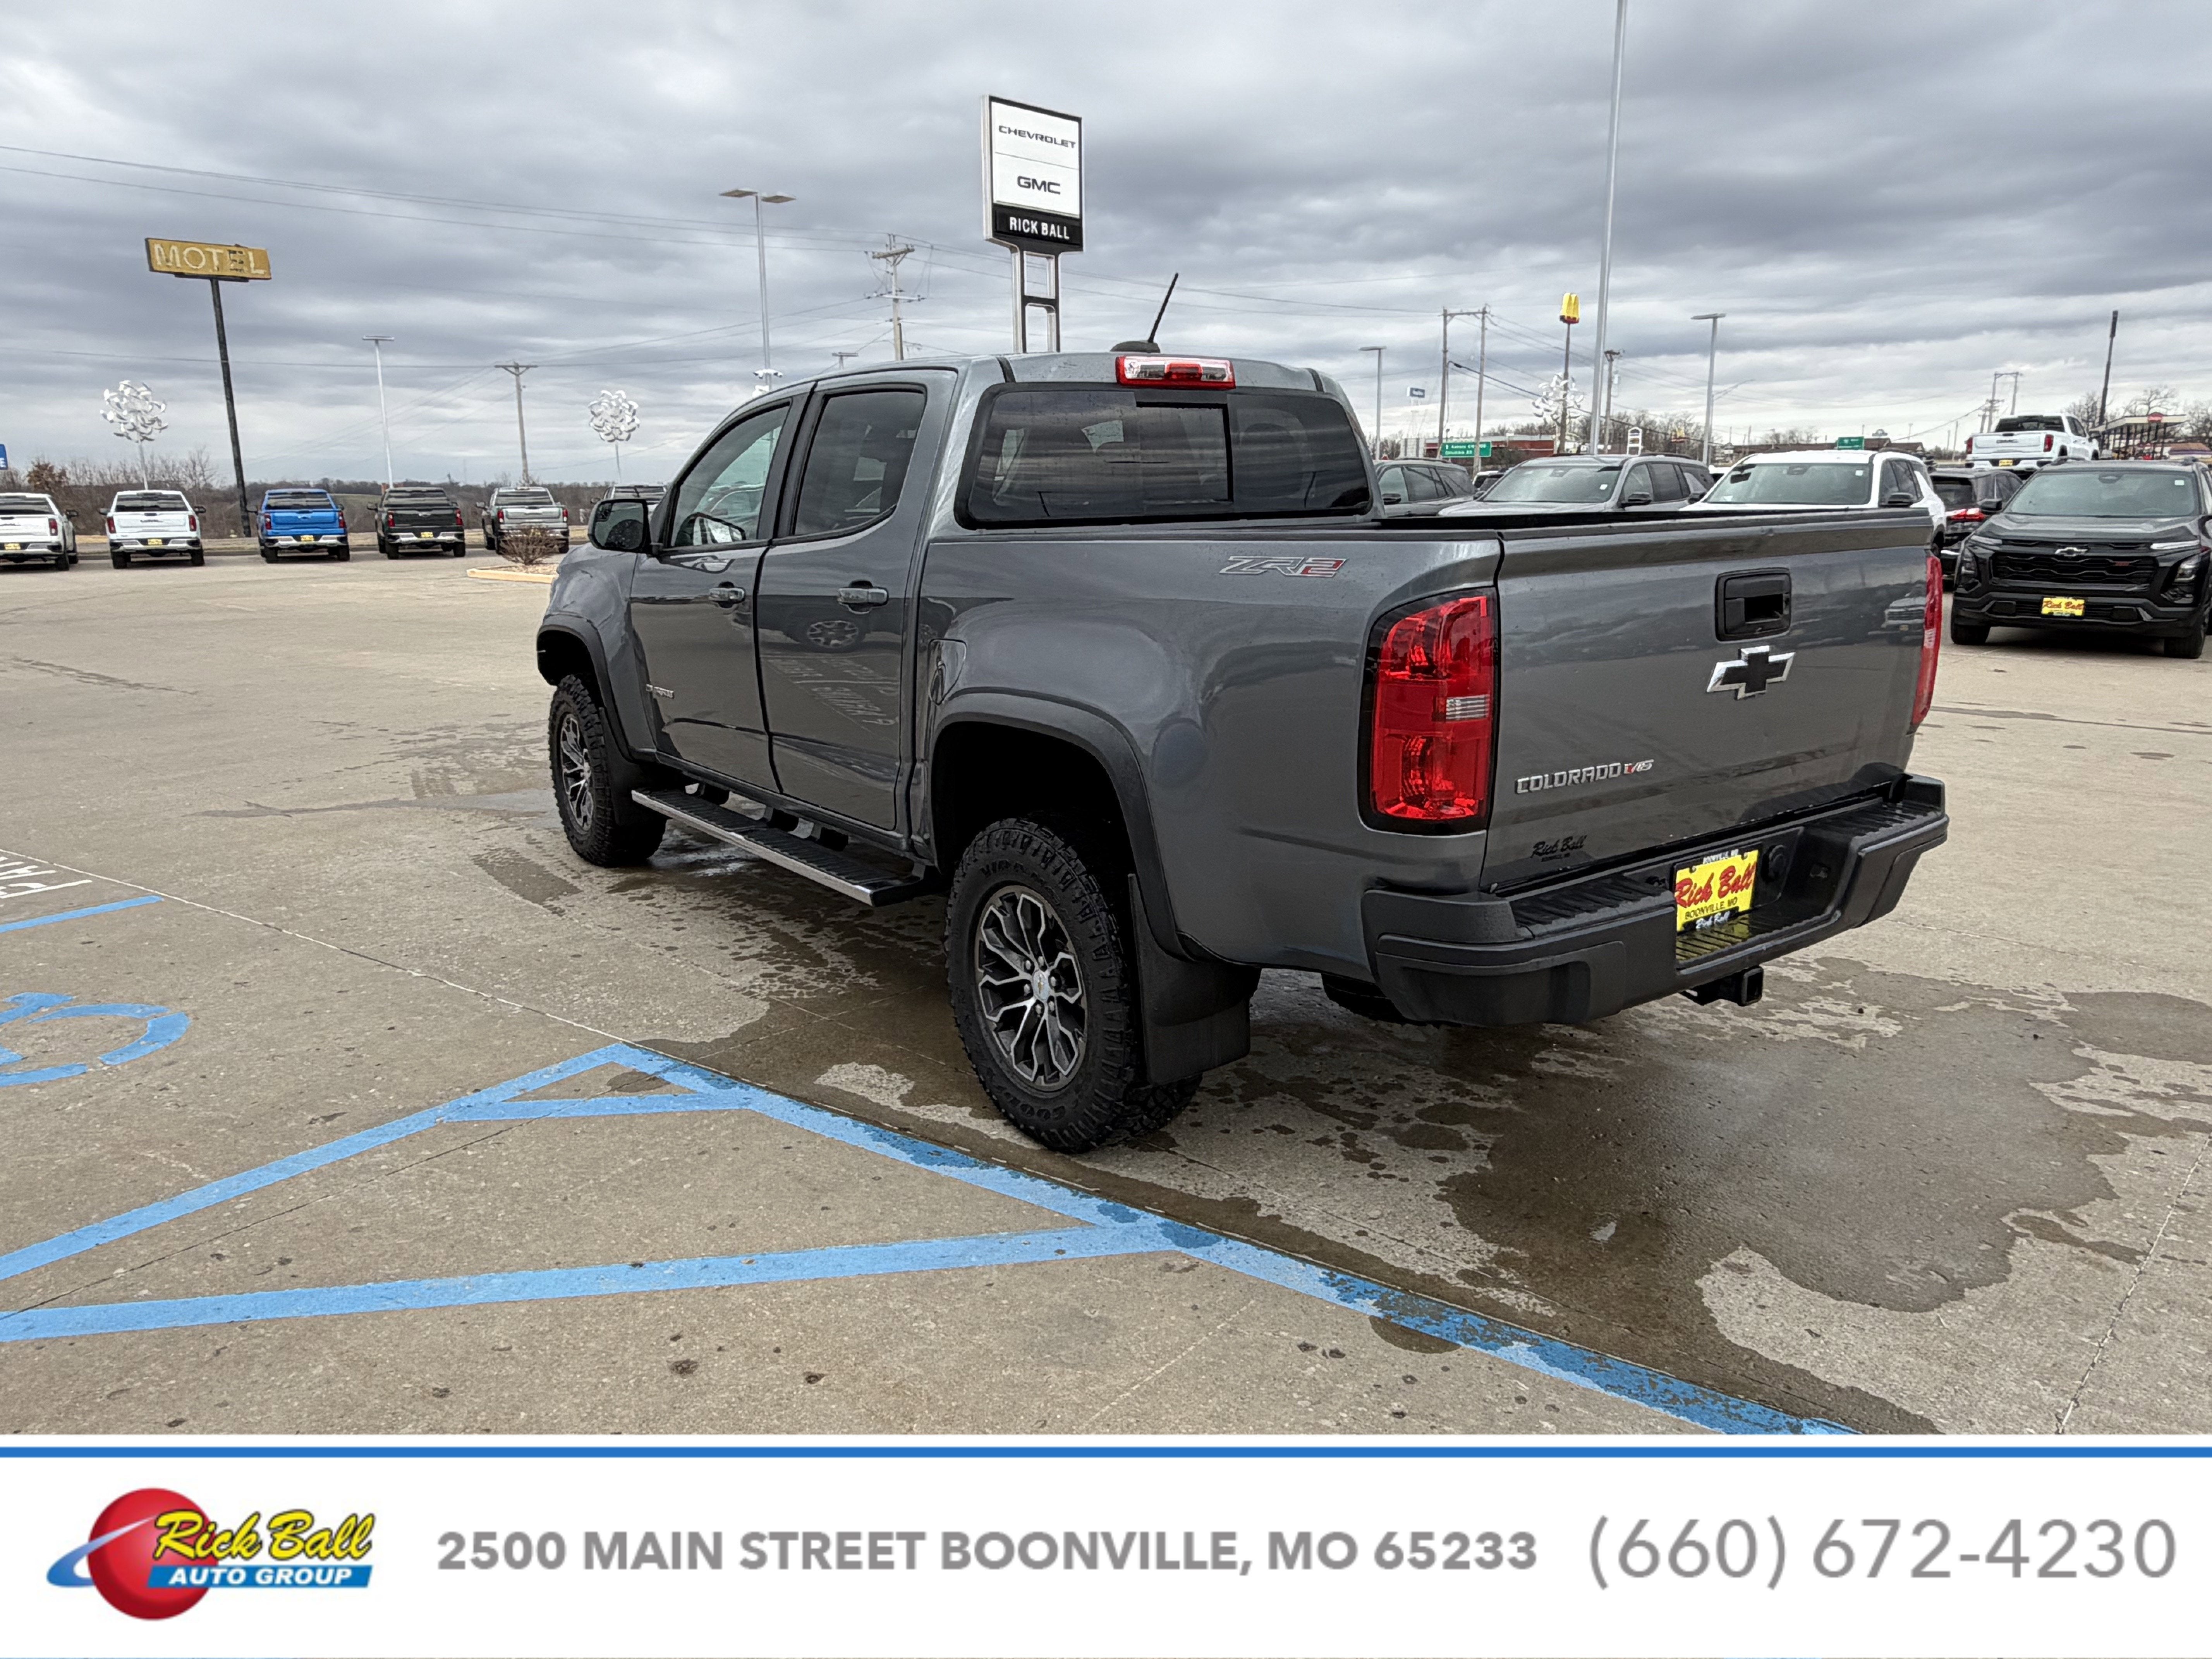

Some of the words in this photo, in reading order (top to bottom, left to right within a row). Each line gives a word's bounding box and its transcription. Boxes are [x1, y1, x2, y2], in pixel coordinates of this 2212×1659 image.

[998, 125, 1076, 149] CHEVROLET
[1017, 176, 1061, 195] GMC
[1009, 217, 1039, 235] RICK
[1041, 222, 1070, 239] BALL
[154, 243, 266, 274] MOTEL
[1220, 555, 1347, 577] ZR2
[1515, 762, 1621, 794] COLORADO
[1675, 872, 1714, 908] Rick
[1718, 860, 1757, 899] Ball
[1685, 901, 1725, 920] BOONVILLE
